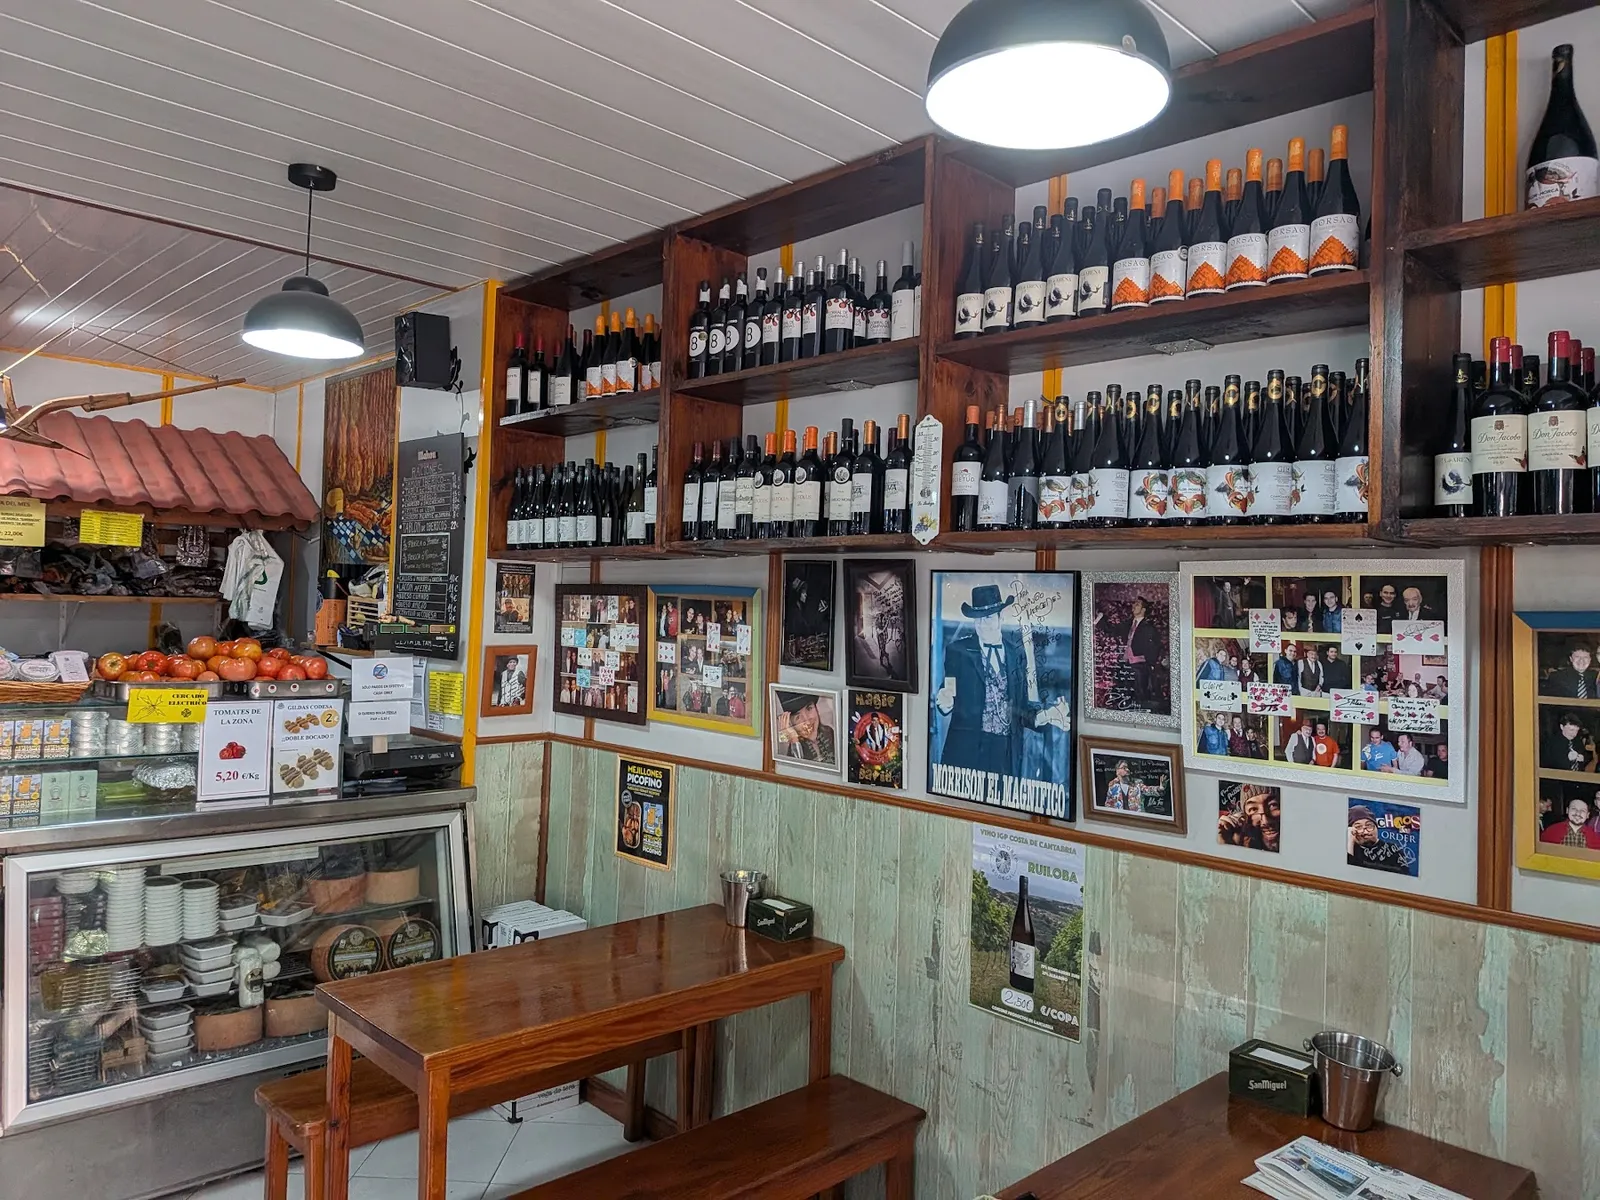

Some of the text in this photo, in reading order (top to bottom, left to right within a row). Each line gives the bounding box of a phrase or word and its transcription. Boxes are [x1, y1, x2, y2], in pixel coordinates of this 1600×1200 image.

[710, 333, 718, 348] 8
[746, 326, 753, 342] 8
[690, 336, 698, 350] 8
[1477, 431, 1521, 443] Don Jacobo
[1532, 428, 1550, 440] Don
[1549, 427, 1578, 440] Jacobo
[326, 713, 333, 722] 2
[215, 771, 260, 783] 5,20 €/Kg
[628, 765, 663, 779] MEJILLONES
[627, 772, 662, 789] PICOFINO
[932, 763, 986, 802] MORRISON
[986, 772, 1001, 805] EL
[980, 828, 1077, 855] VINO IGP COSTA DE CANTABRIA
[1381, 830, 1416, 844] ORDER
[1027, 861, 1079, 884] RUILOBA
[1040, 1005, 1079, 1026] €/COPA
[1248, 1079, 1288, 1092] SanMiguel
